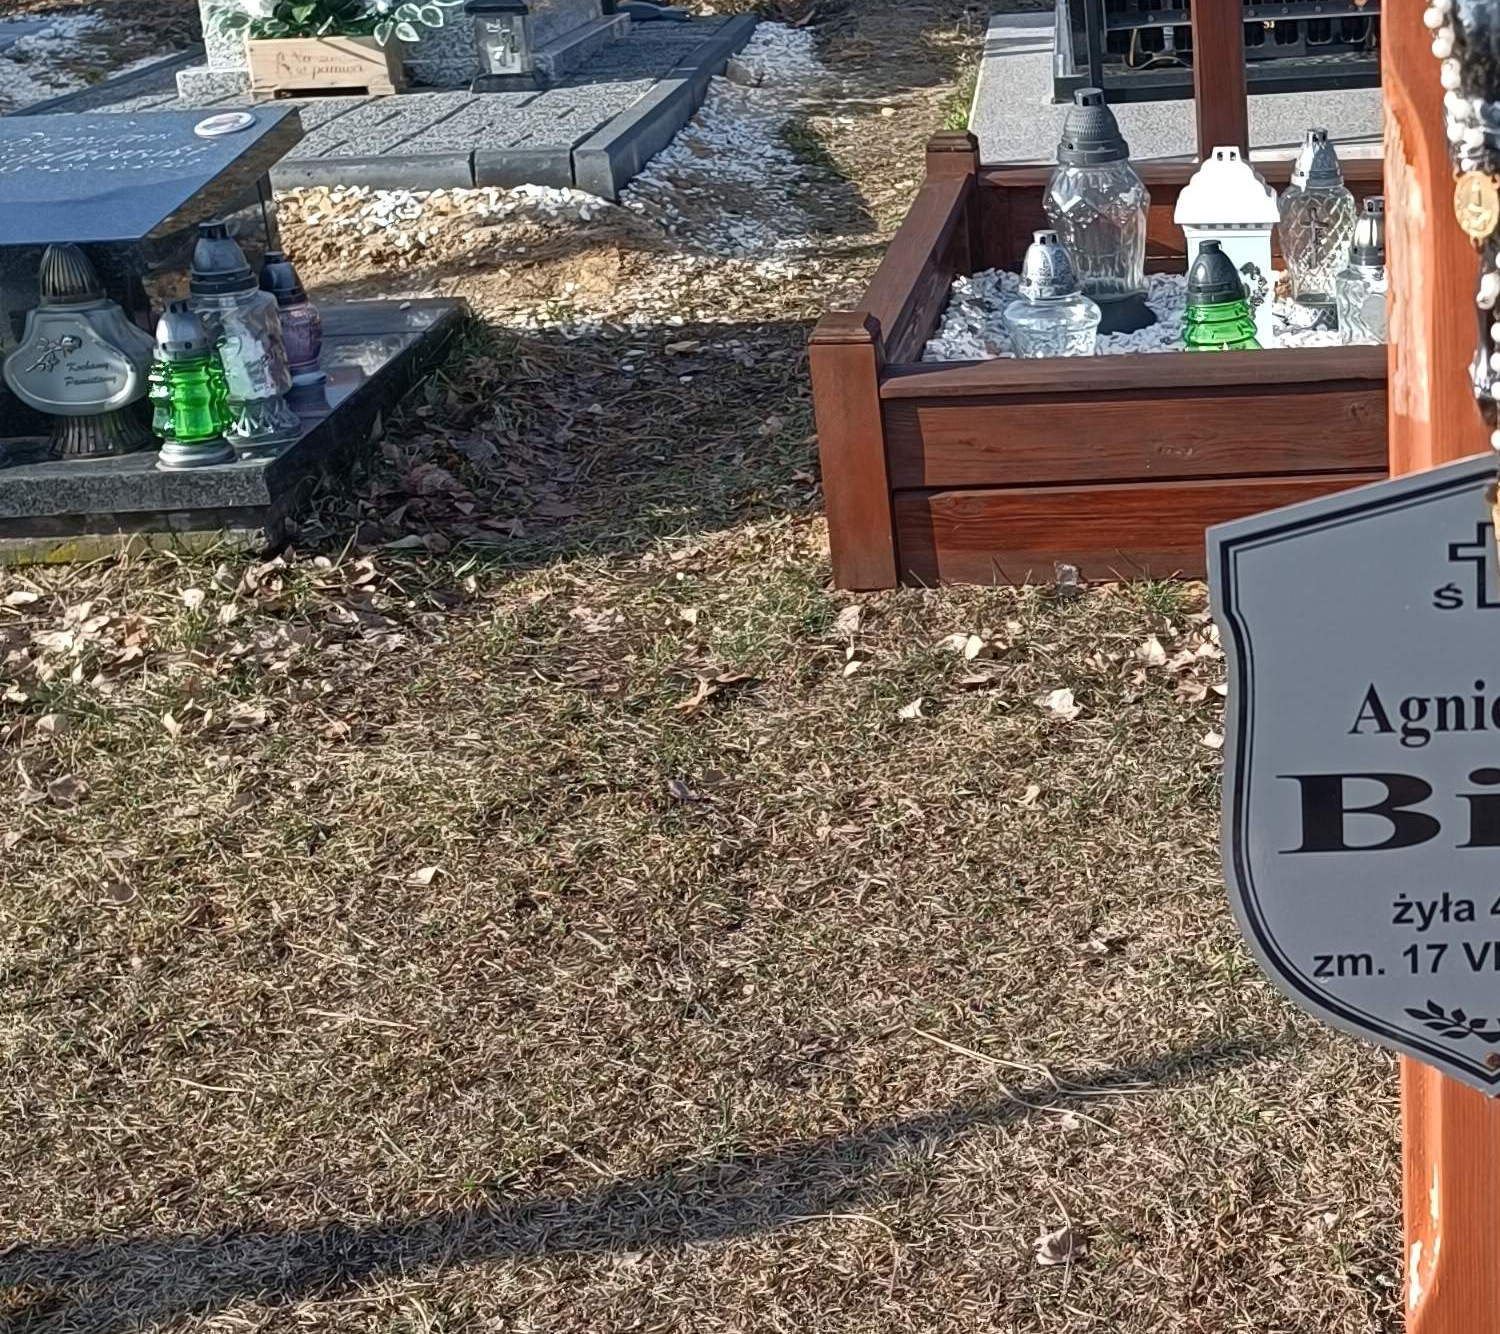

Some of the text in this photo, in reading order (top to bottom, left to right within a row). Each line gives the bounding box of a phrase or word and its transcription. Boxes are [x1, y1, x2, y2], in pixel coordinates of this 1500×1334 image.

[1391, 892, 1476, 932] żyła
[1312, 951, 1386, 978] zm.
[1402, 943, 1449, 975] 17
